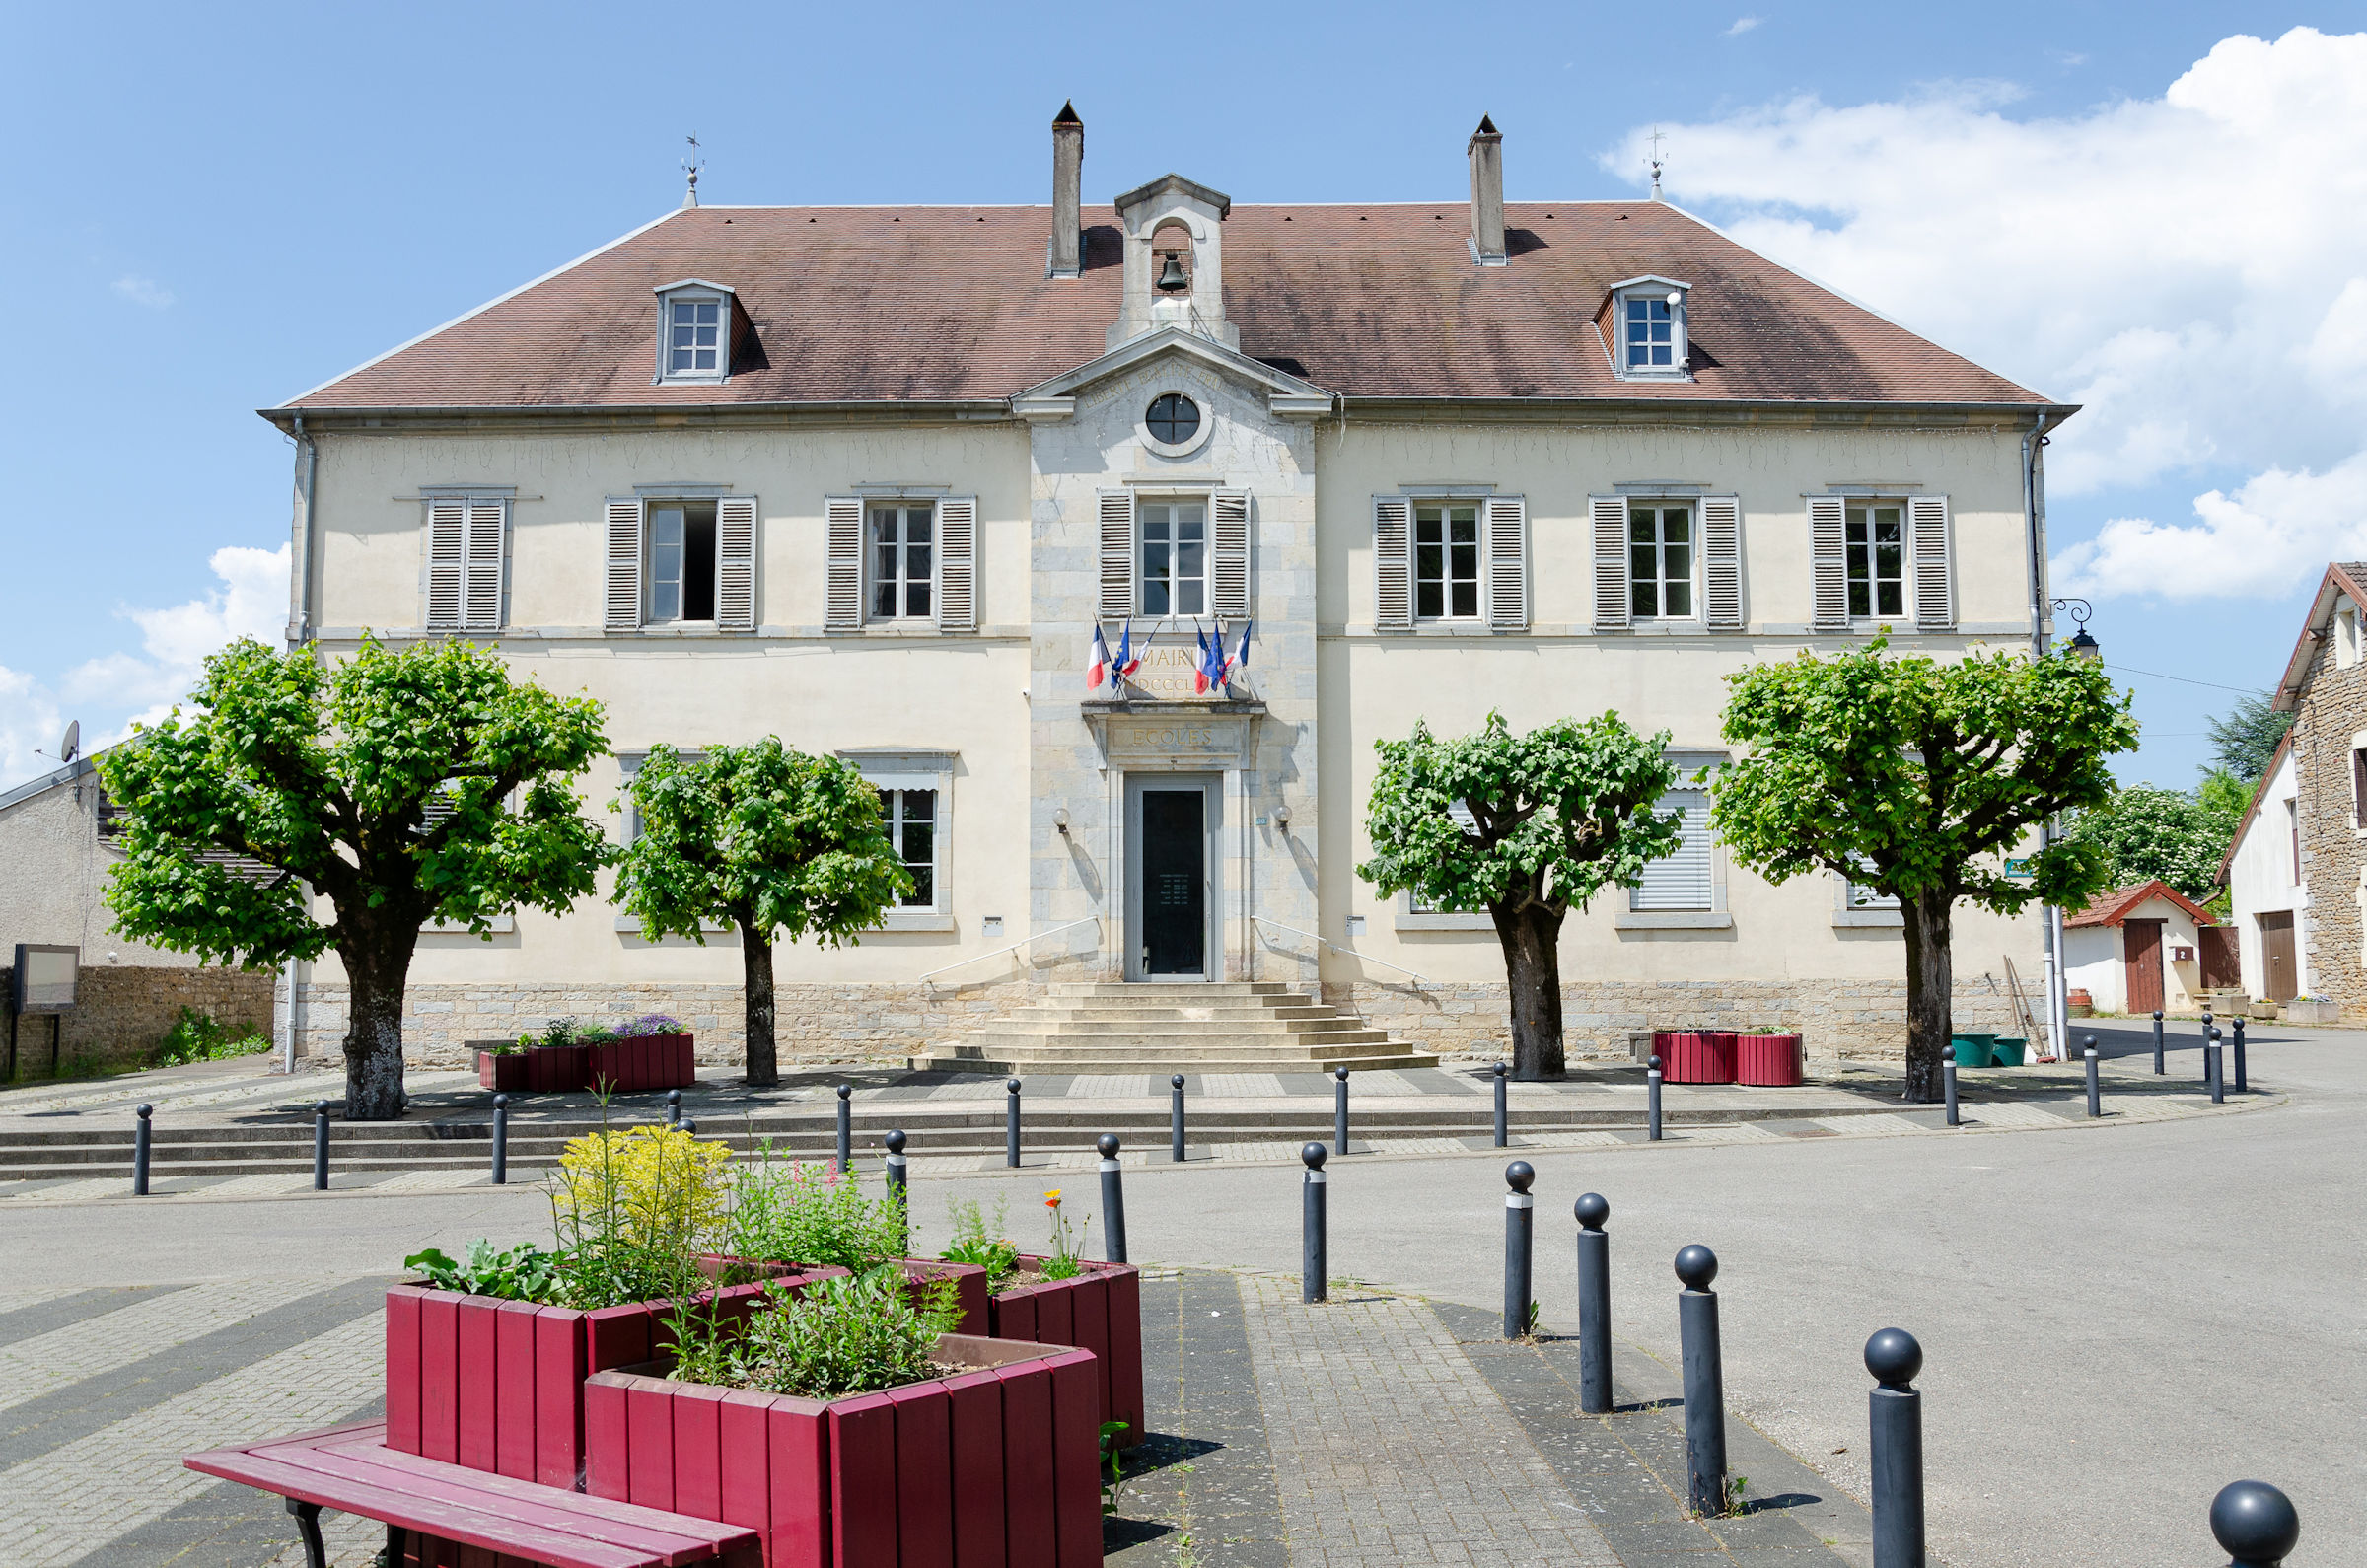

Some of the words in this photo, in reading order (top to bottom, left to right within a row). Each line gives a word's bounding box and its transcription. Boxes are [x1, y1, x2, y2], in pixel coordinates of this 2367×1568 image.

[1083, 378, 1133, 409] LIBERTE
[1143, 649, 1197, 667] MAIRI
[1133, 729, 1212, 745] ECOLES
[2180, 950, 2186, 960] 2
